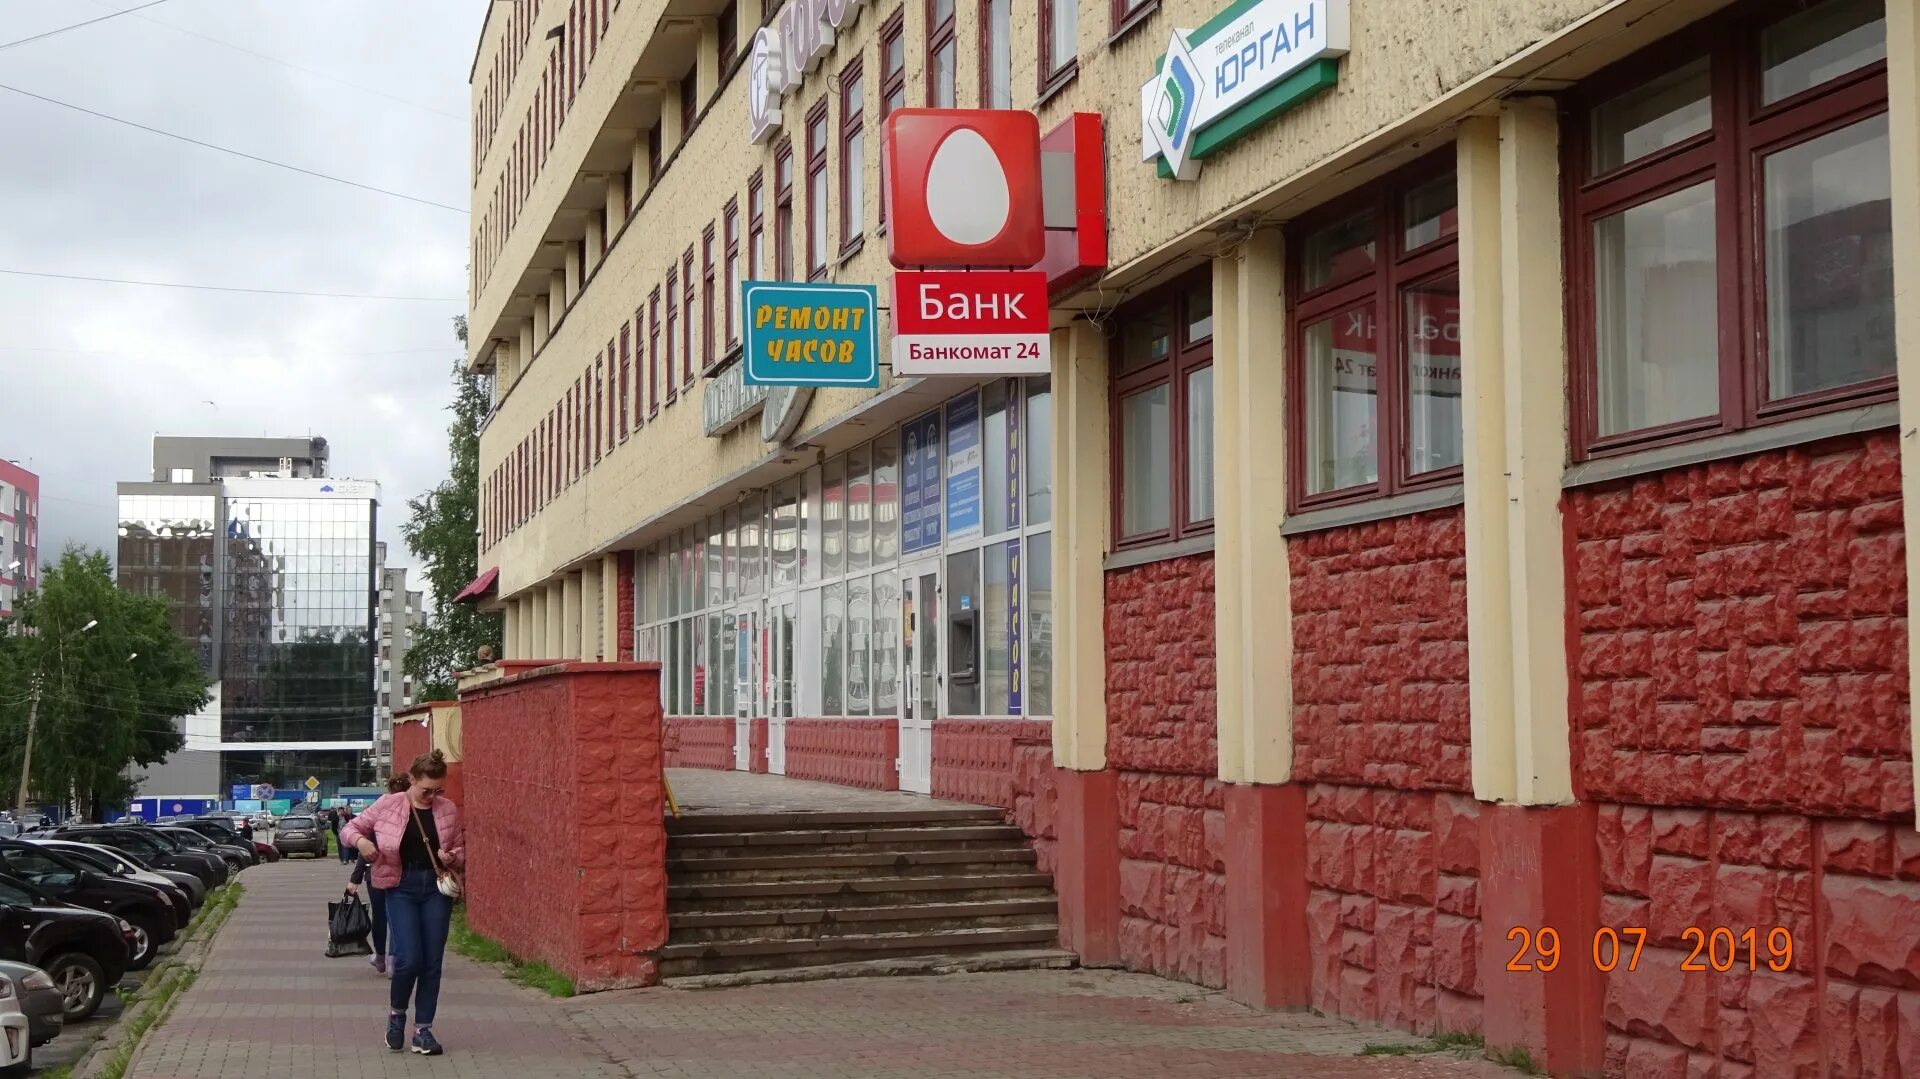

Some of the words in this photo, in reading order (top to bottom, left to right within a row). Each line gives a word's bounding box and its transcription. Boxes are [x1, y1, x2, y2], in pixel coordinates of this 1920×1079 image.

[1214, 21, 1254, 56] телеканал
[1215, 3, 1314, 99] ЮРГАН
[755, 304, 865, 331] РЕМОНТ
[919, 283, 1027, 320] Банк
[767, 339, 855, 364] ЧАСОВ
[909, 343, 1012, 360] Банкомат
[1016, 342, 1040, 359] 24
[1010, 380, 1018, 523] РЕМОНТ
[1011, 555, 1019, 693] ЧАСОВ
